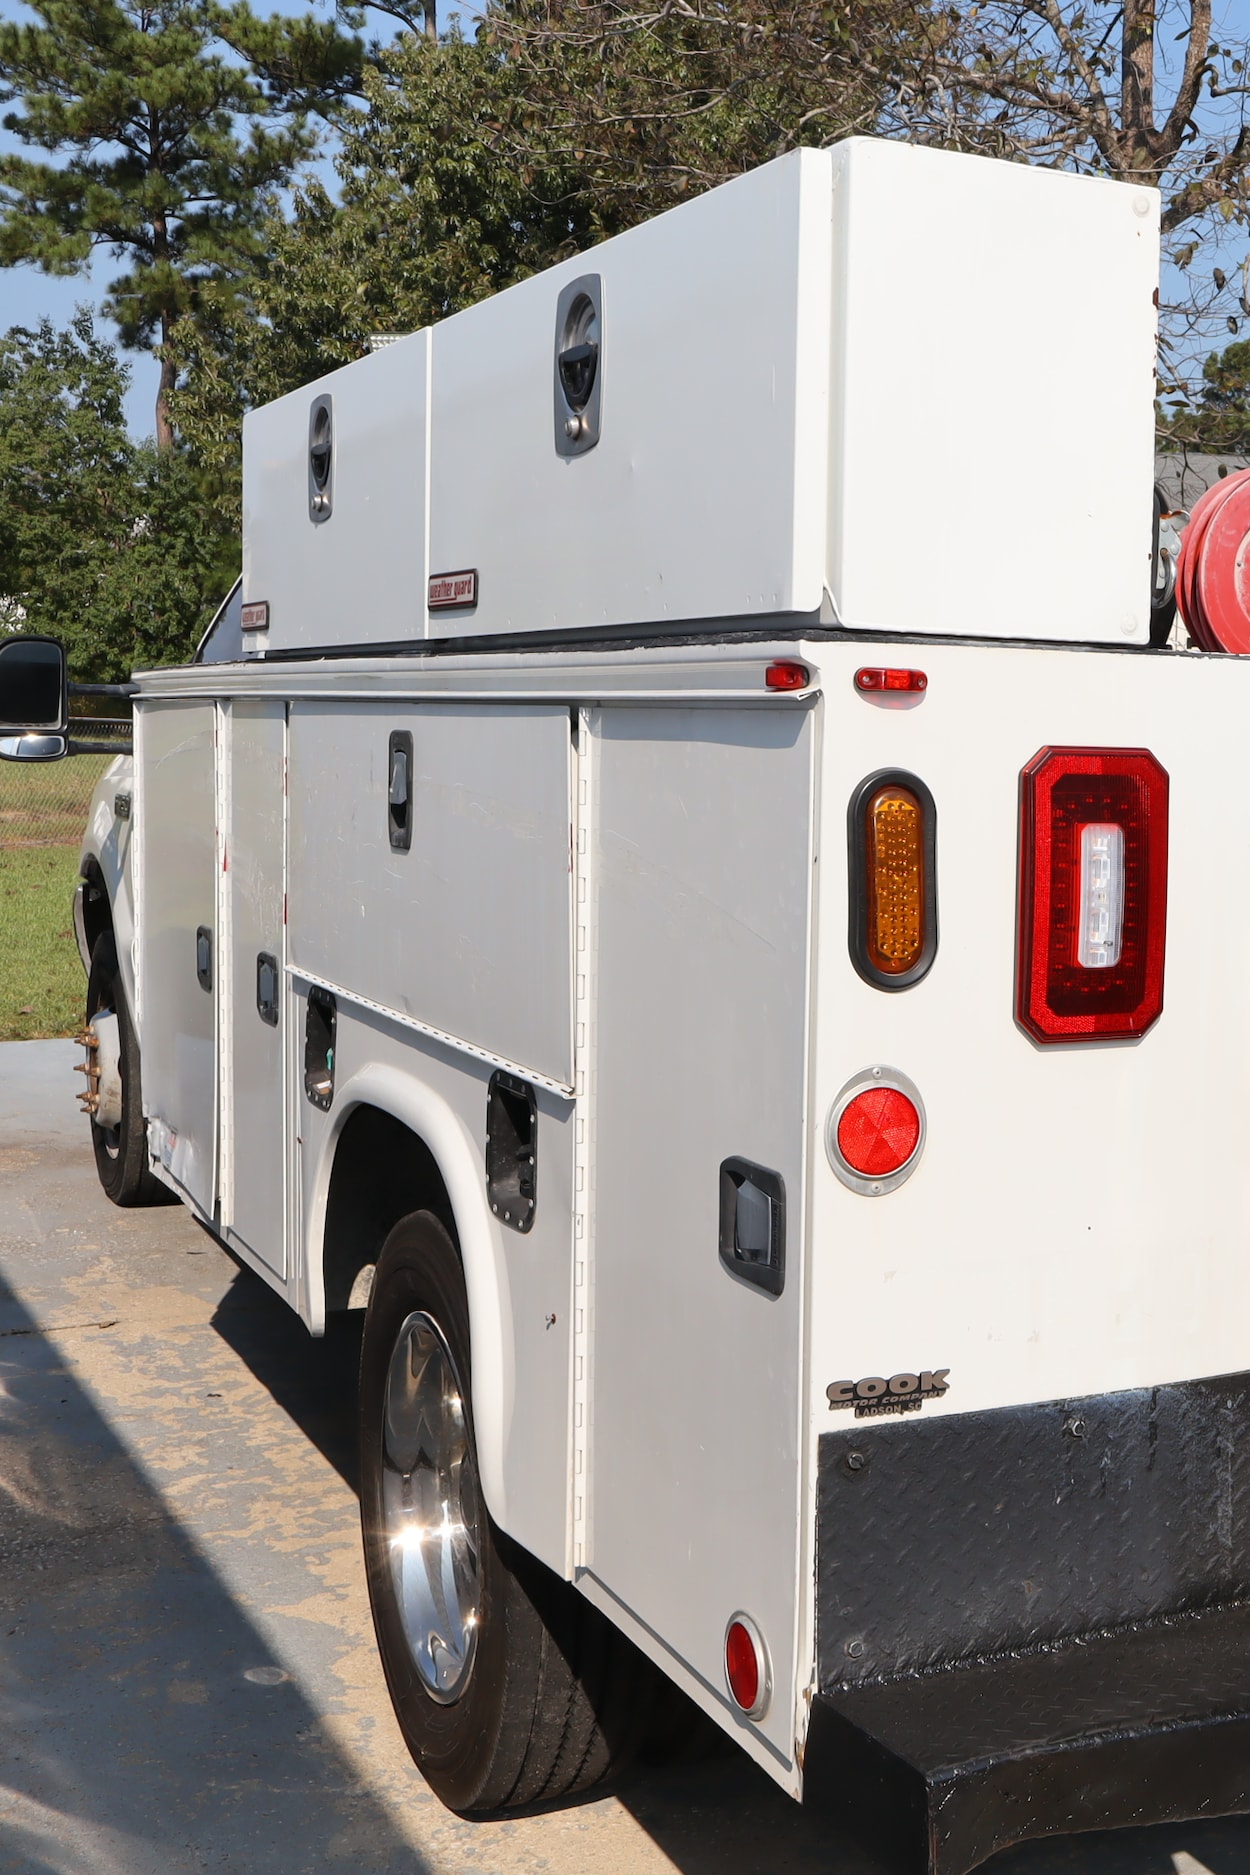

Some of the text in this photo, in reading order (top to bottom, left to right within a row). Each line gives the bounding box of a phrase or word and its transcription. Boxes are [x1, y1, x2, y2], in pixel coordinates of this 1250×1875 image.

[826, 1368, 950, 1401] COOK
[828, 1390, 947, 1411] MOTOR COMPANY
[855, 1401, 923, 1419] LADSON, SC
